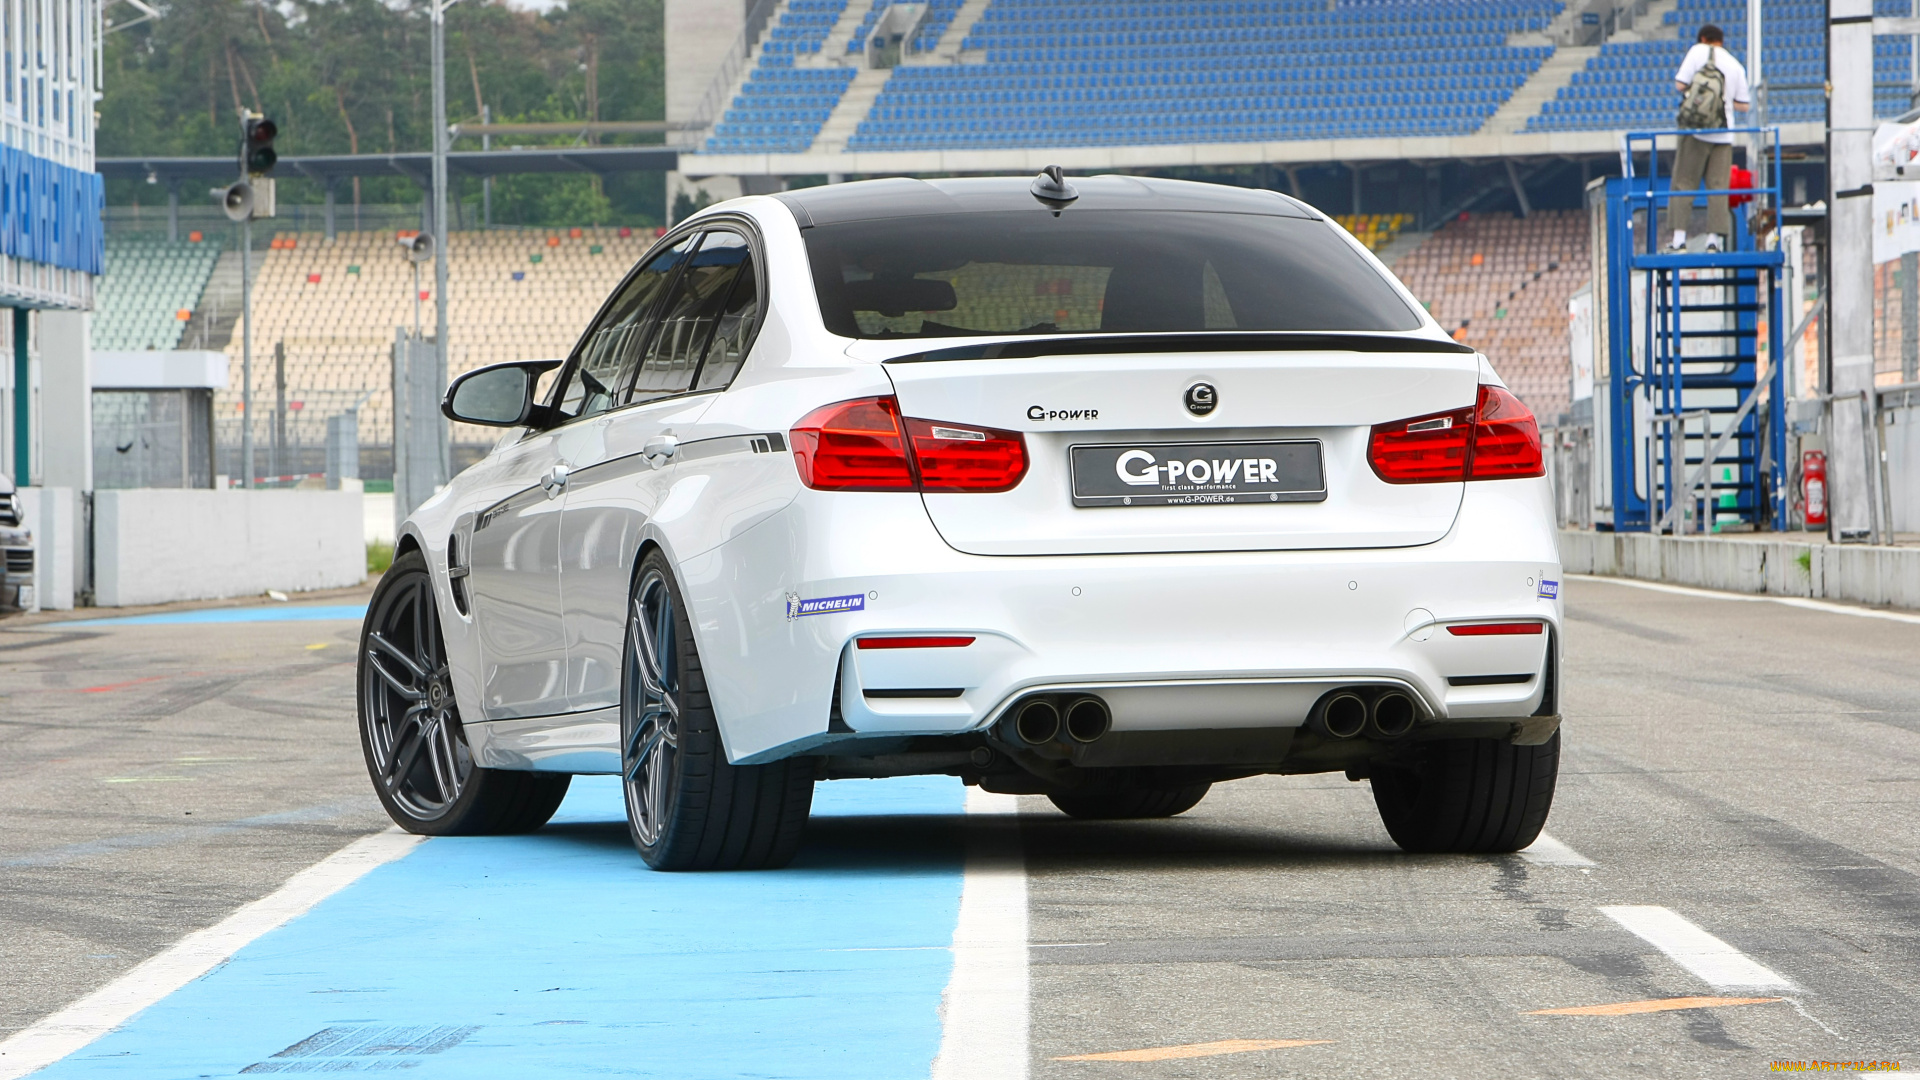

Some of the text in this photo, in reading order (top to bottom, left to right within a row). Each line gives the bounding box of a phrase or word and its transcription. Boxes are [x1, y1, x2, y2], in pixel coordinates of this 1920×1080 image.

[1026, 405, 1099, 421] G-POWER
[1116, 449, 1279, 486] G-POWER
[1167, 494, 1235, 504] www.G-POWER.de
[802, 598, 862, 611] MICHELIN
